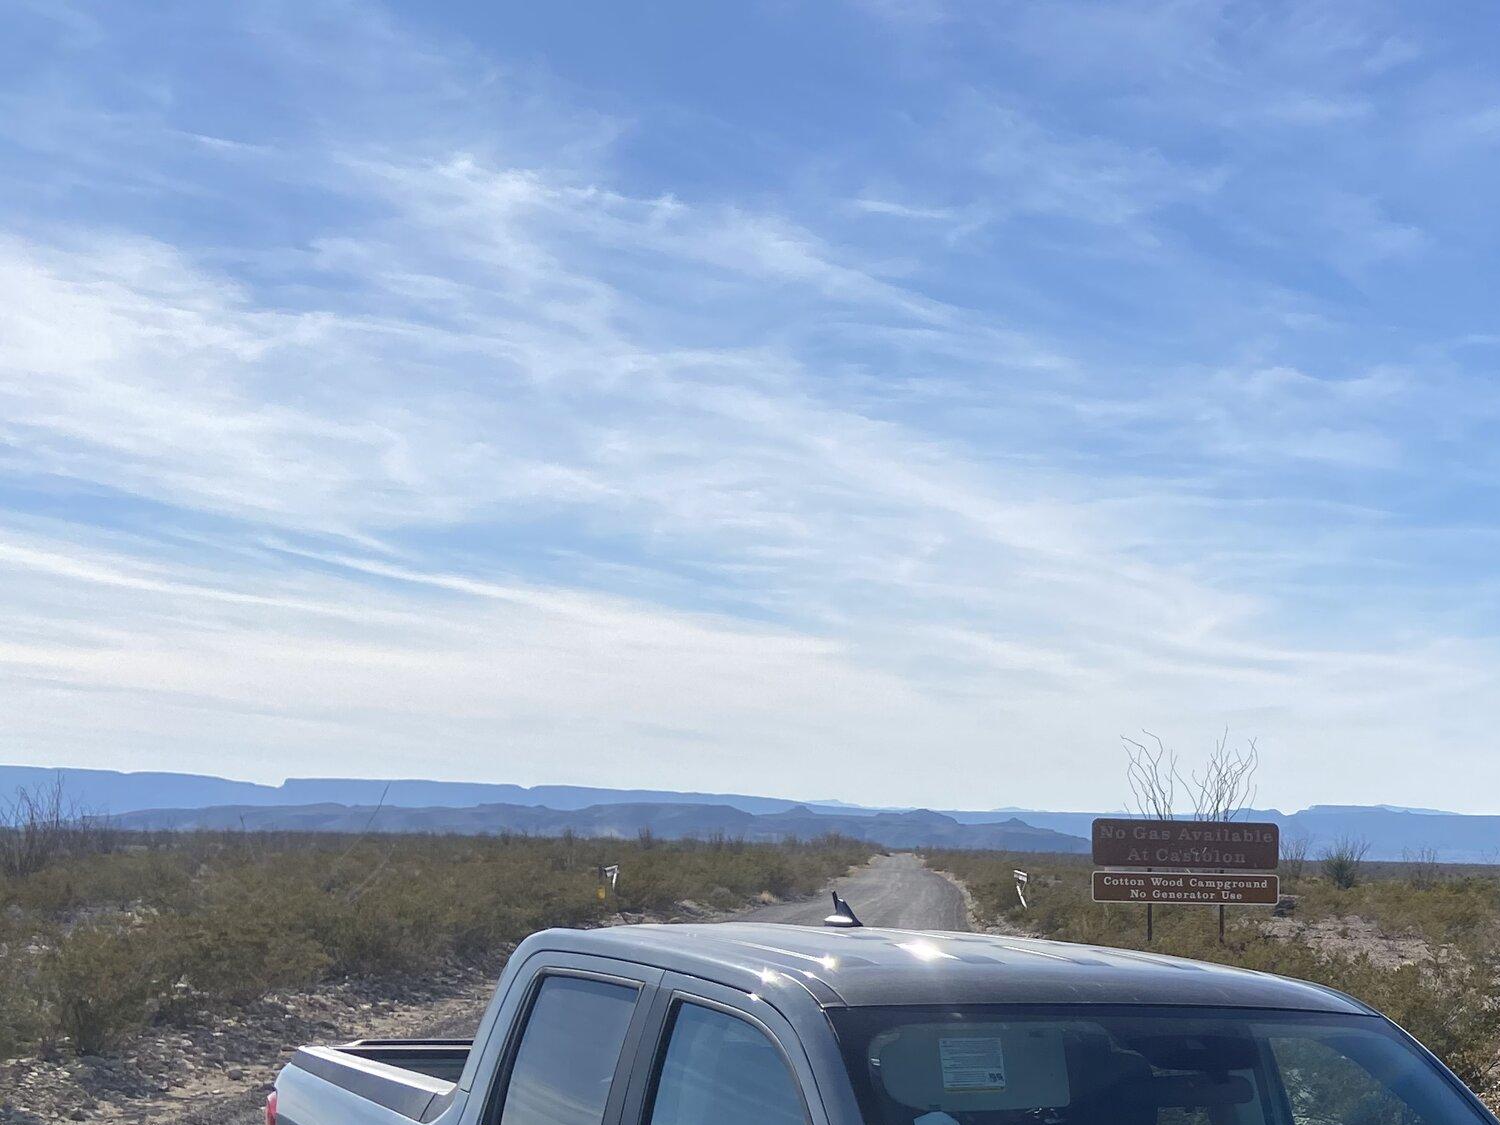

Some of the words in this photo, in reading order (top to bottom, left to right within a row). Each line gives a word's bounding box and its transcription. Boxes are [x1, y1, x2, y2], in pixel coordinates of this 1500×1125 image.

[1099, 825, 1126, 840] No
[1132, 827, 1171, 840] Gas
[1178, 828, 1274, 843] Available
[1127, 848, 1148, 861] At
[1103, 877, 1145, 886] Cotton
[1151, 877, 1184, 887] Wood
[1189, 878, 1268, 889] Campground
[1130, 889, 1147, 899] No
[1152, 890, 1215, 899] Generator
[1222, 891, 1242, 899] Use
